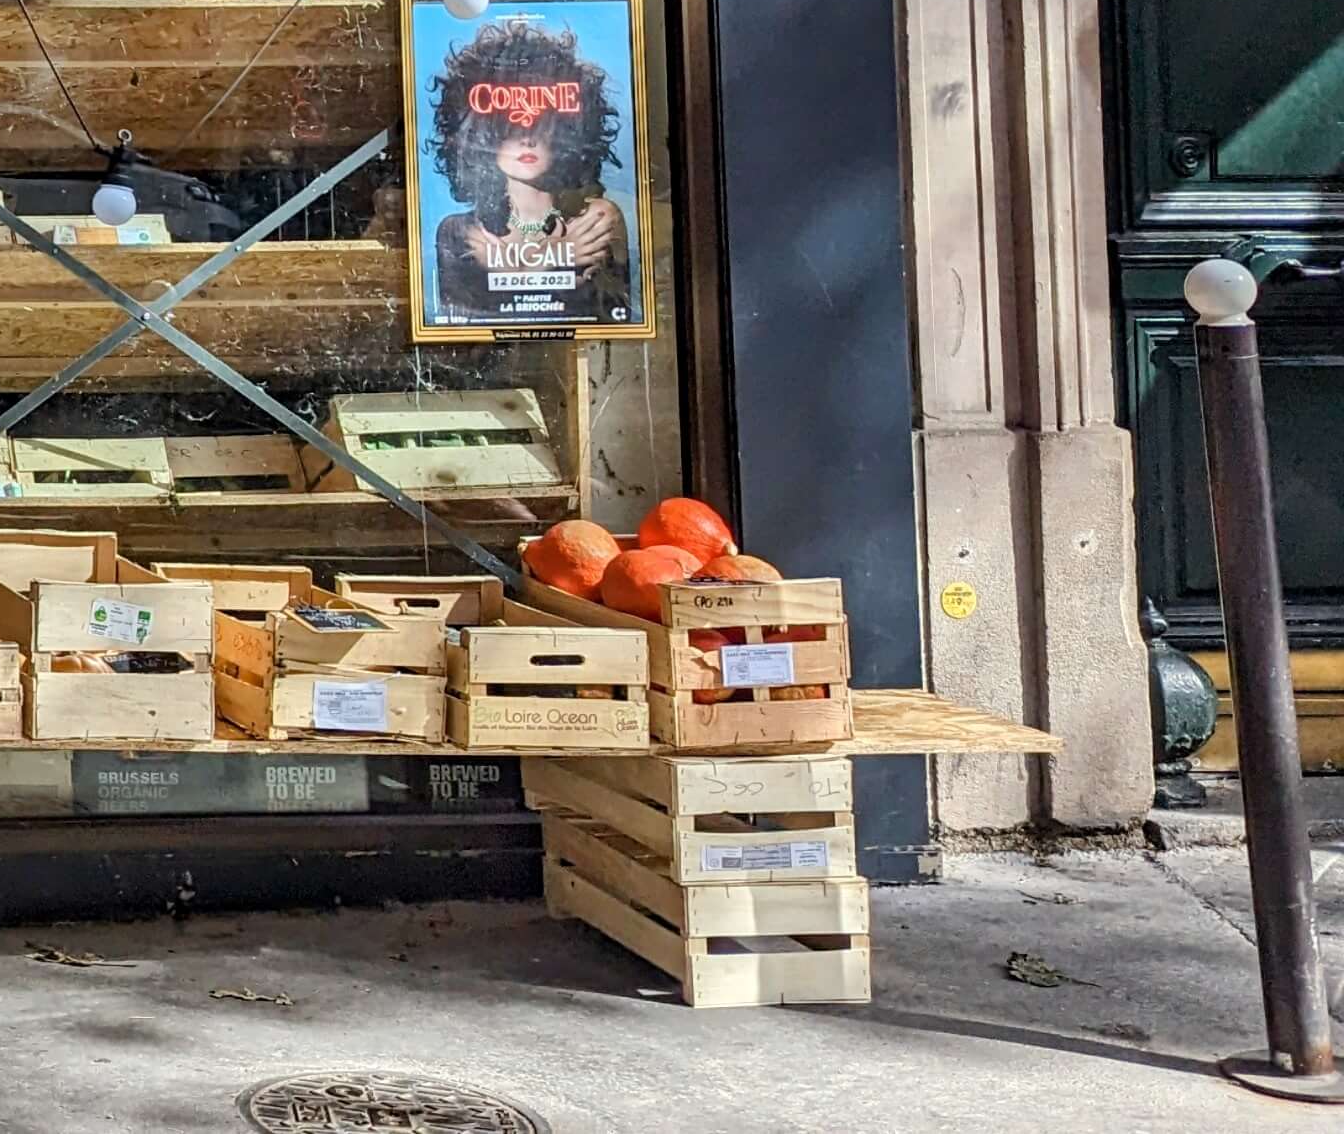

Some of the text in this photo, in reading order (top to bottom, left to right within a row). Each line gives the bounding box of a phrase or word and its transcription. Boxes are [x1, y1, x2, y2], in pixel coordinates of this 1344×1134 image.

[469, 82, 580, 128] CORINE
[506, 239, 576, 268] CIGALE
[493, 277, 508, 286] 12
[541, 275, 572, 286] 2023
[500, 303, 514, 312] LA
[473, 706, 599, 725] Bio Loire Ocean
[97, 771, 180, 785] BRUSSELS
[265, 767, 337, 784] BREWED
[429, 765, 500, 783] BREWED
[97, 785, 169, 800] ORGANIC
[266, 784, 316, 800] TO BE
[430, 782, 480, 799] TO BE
